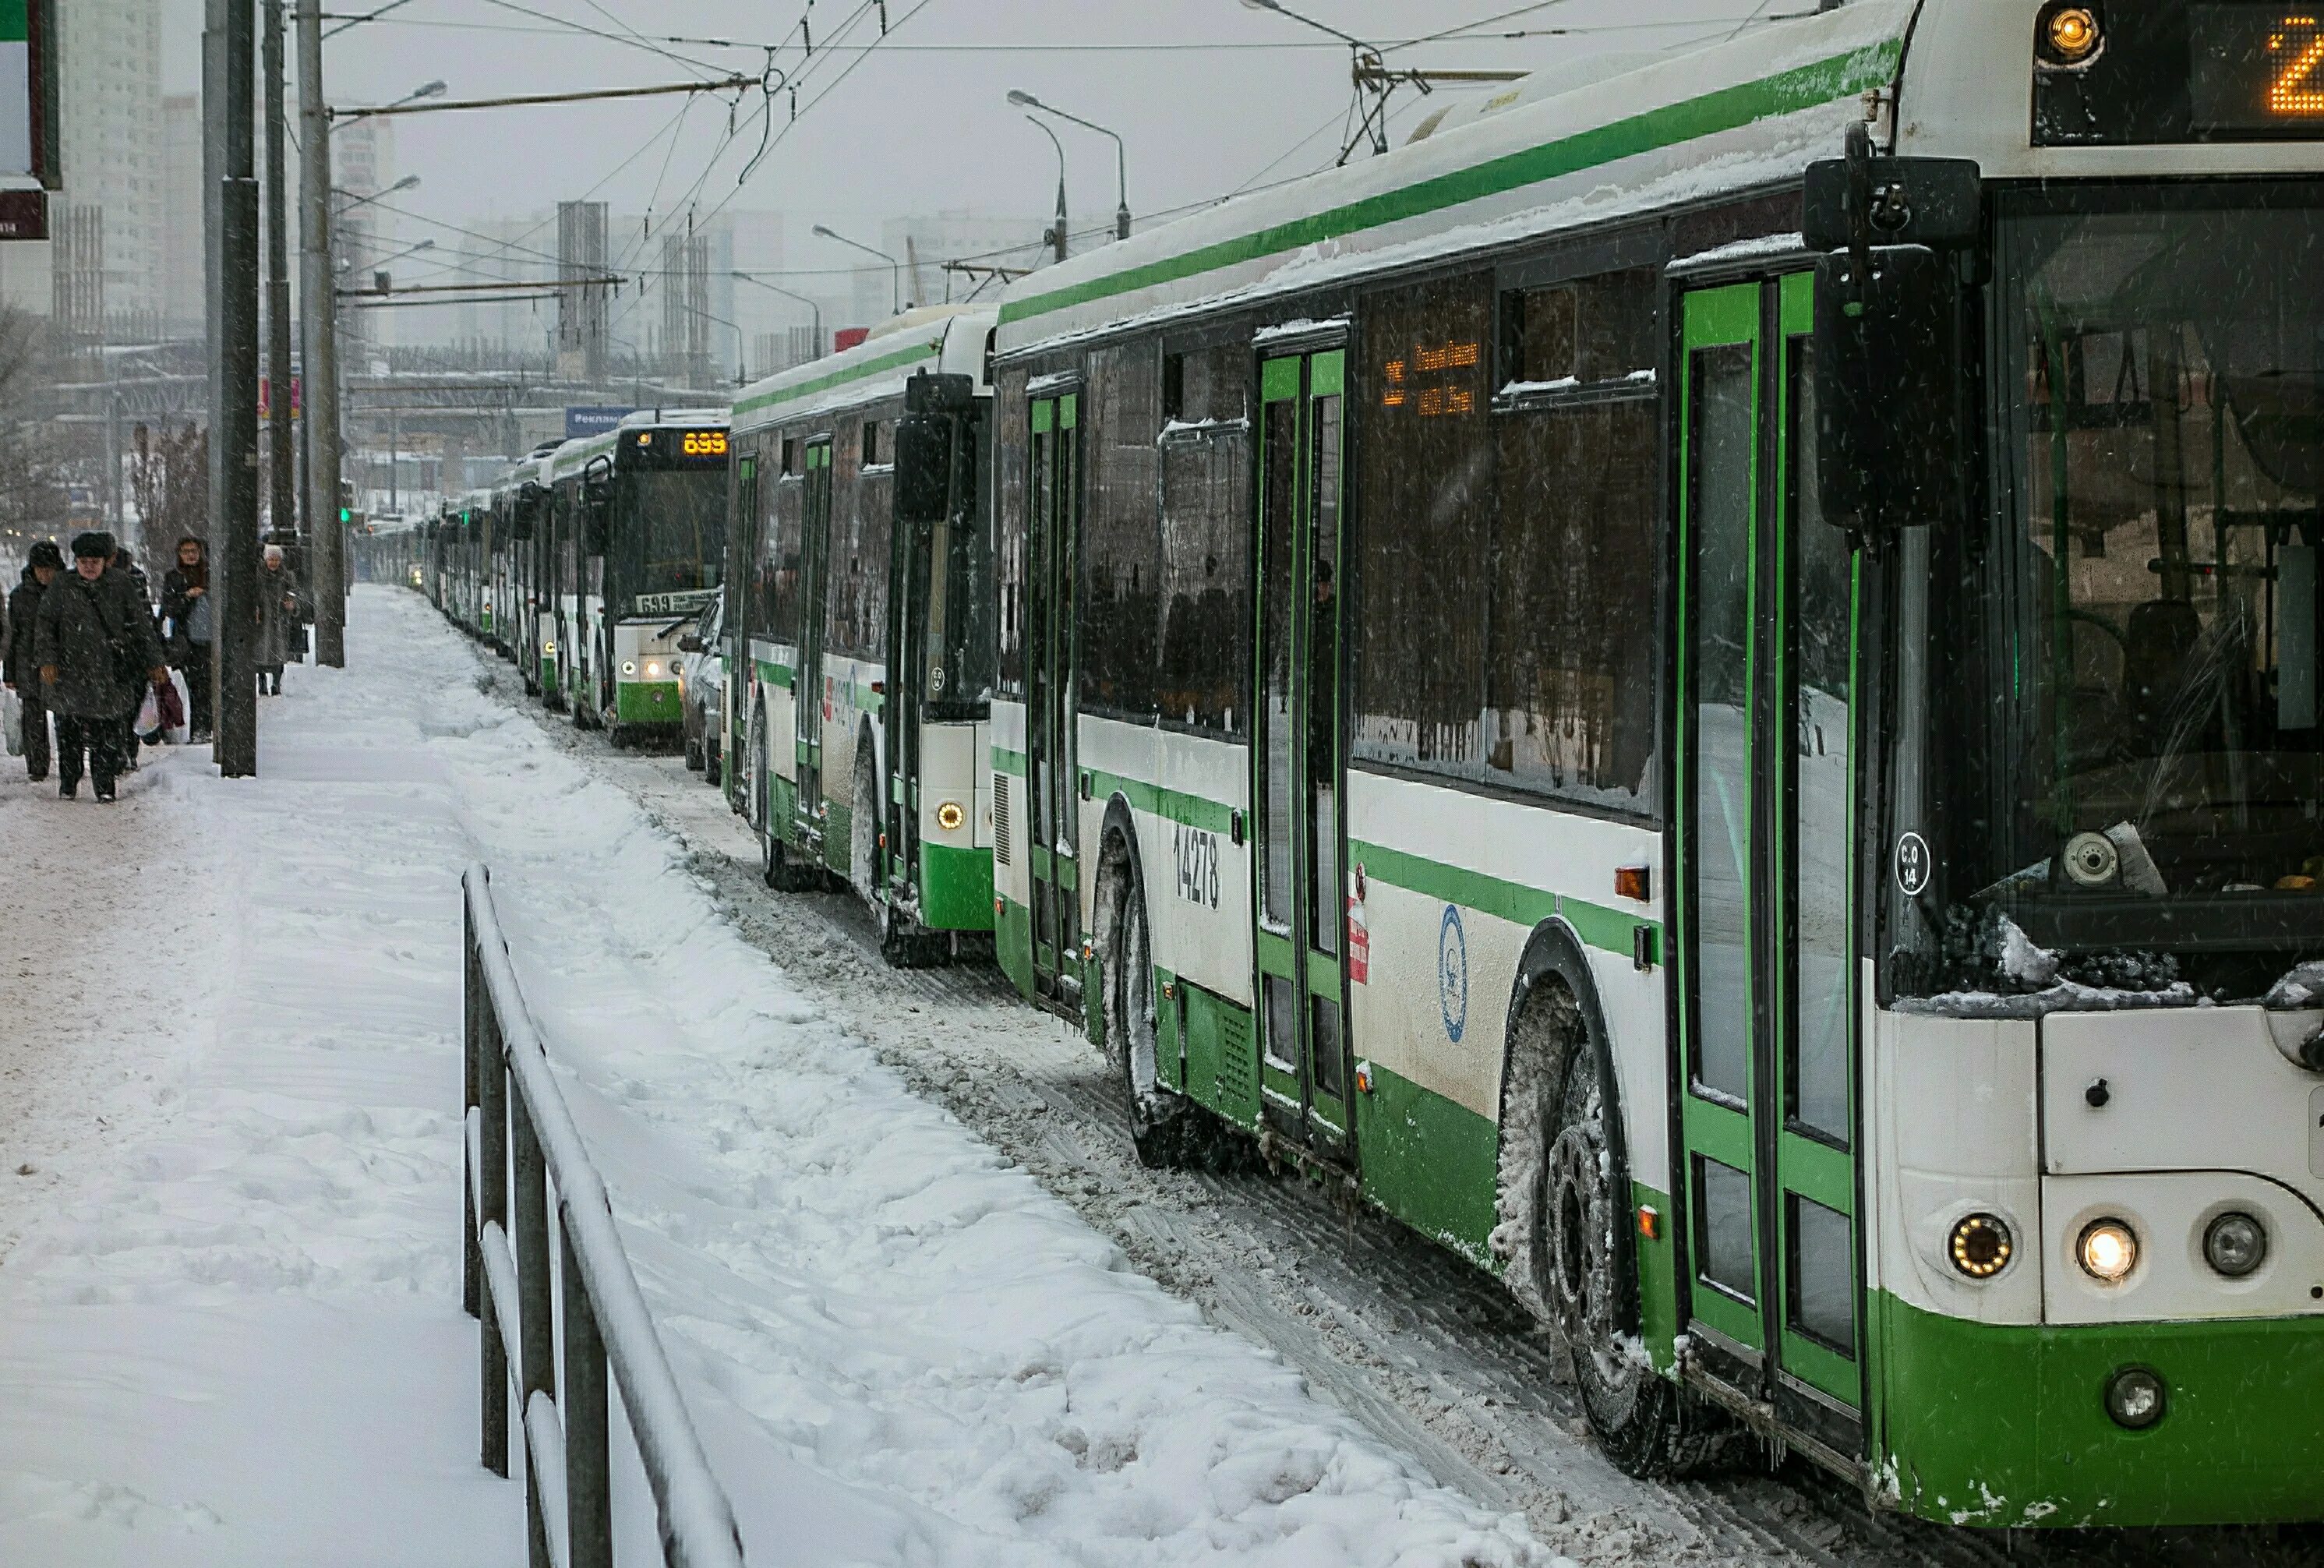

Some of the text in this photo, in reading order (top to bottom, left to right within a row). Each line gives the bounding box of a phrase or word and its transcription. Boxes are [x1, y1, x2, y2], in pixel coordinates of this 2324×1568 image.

[684, 433, 726, 454] 699
[641, 595, 670, 612] 699
[1173, 824, 1218, 910] 14278
[1905, 867, 1916, 885] 14
